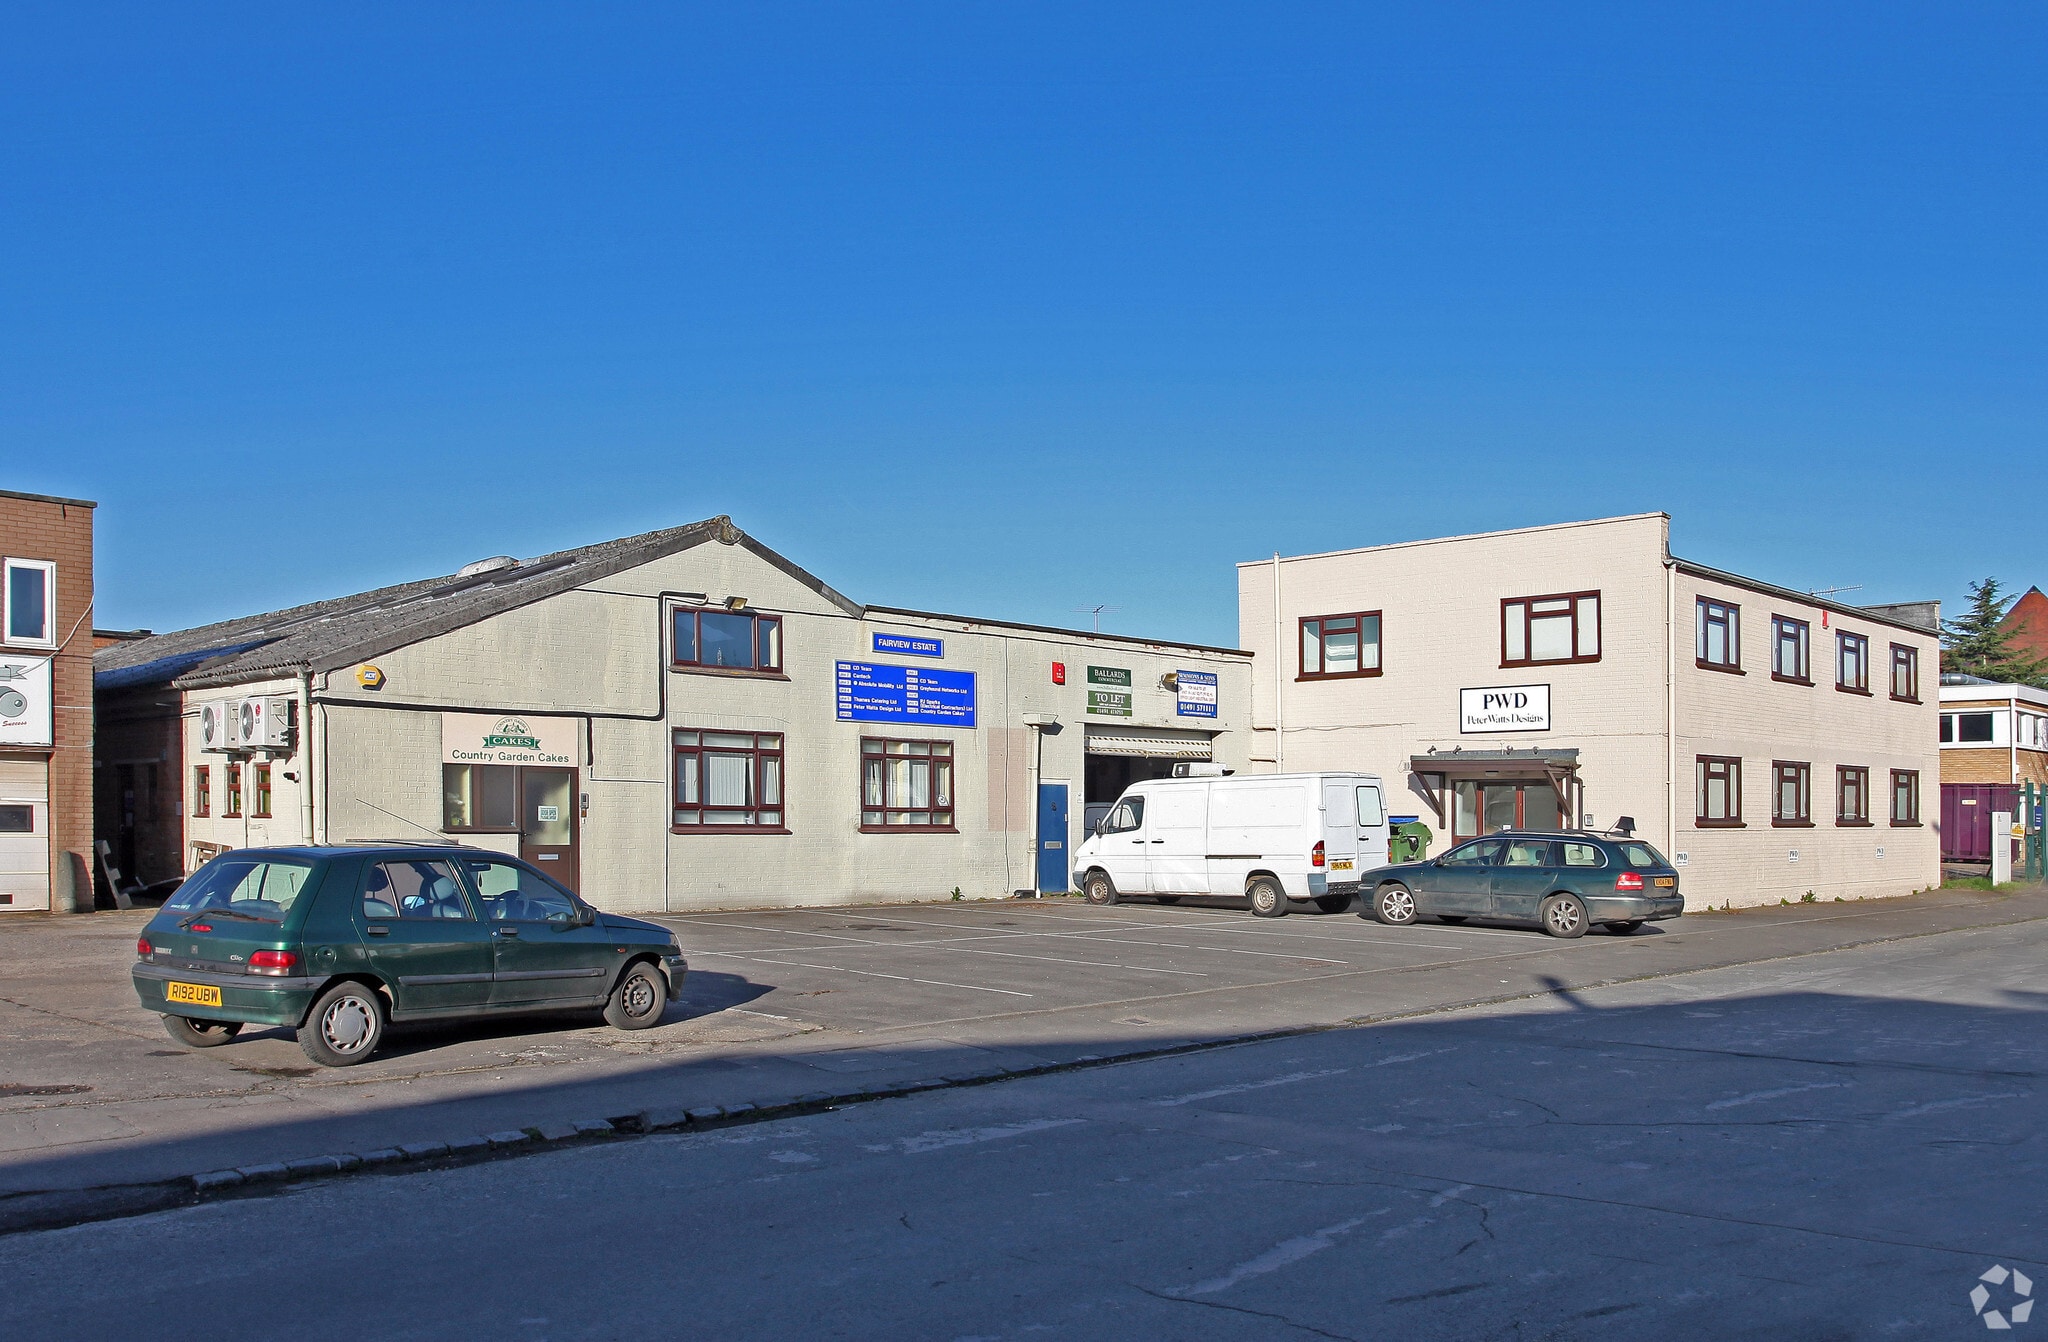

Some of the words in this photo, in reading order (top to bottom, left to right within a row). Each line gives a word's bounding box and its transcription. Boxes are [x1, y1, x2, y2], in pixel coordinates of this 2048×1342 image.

[878, 638, 911, 649] FAIRVIEW
[912, 641, 937, 652] ESTATE
[1094, 669, 1126, 679] BALLARDS
[871, 697, 890, 705] Catering
[1094, 692, 1108, 703] TO
[1110, 694, 1126, 704] LET
[1483, 692, 1528, 710] PWD
[1180, 703, 1196, 711] 01491
[496, 718, 513, 731] COUNTRY
[513, 718, 529, 732] GARDEN
[1467, 715, 1488, 725] Peter
[1488, 714, 1510, 724] Watts
[1511, 713, 1544, 724] Designs
[492, 737, 532, 746] CAKES
[451, 749, 494, 761] Country
[498, 751, 535, 762] Garden
[538, 752, 570, 763] Cakes
[171, 984, 195, 1000] R192
[196, 986, 219, 1003] UBW
